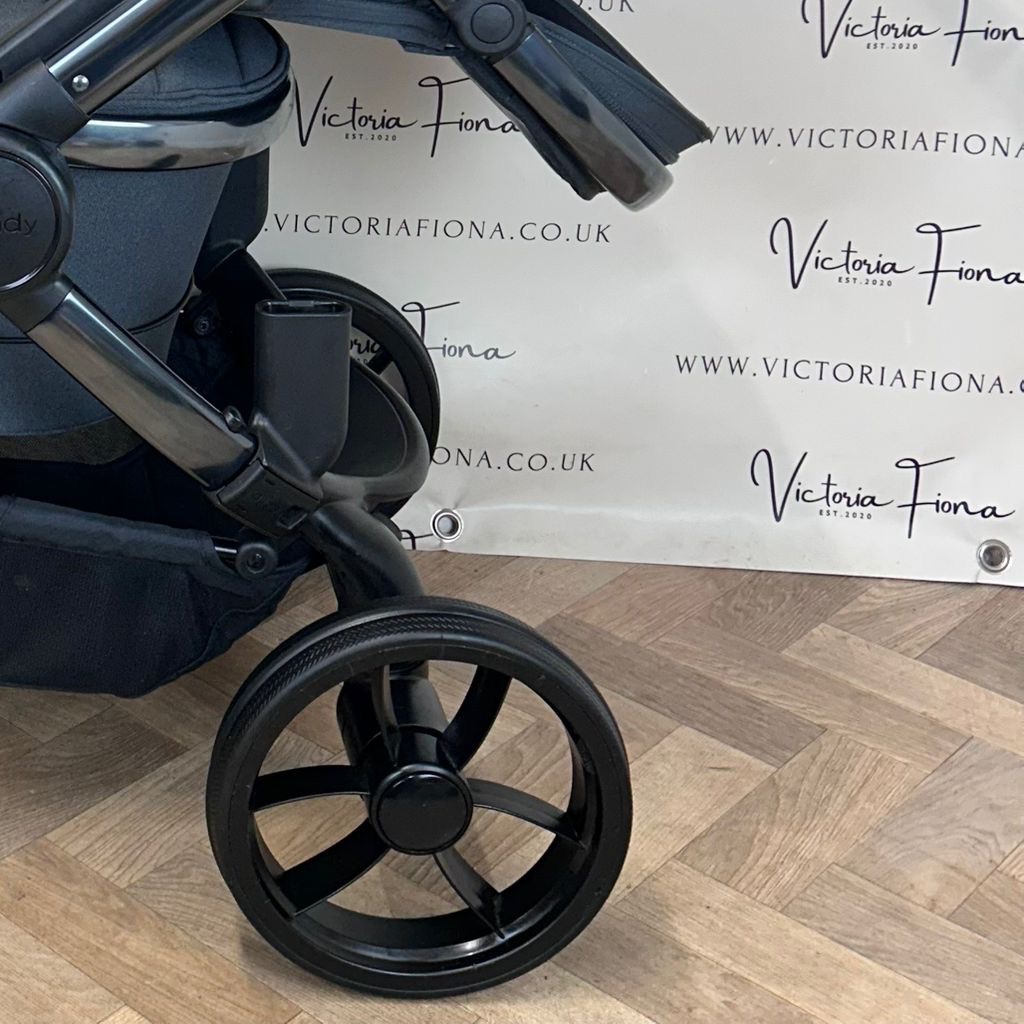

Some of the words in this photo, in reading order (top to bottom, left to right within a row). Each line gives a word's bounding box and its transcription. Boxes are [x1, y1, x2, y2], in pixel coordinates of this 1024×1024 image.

[866, 42, 919, 51] EST.2020
[294, 75, 418, 147] Victoria
[344, 132, 398, 142] EST.2020
[769, 217, 916, 289] Victoria
[837, 276, 893, 287] EST.2020
[675, 354, 1024, 395] WWW.VICTORIAFIONA.
[750, 448, 895, 523] Victoria
[895, 456, 1016, 540] Fiona
[818, 508, 873, 520] EST.2020
